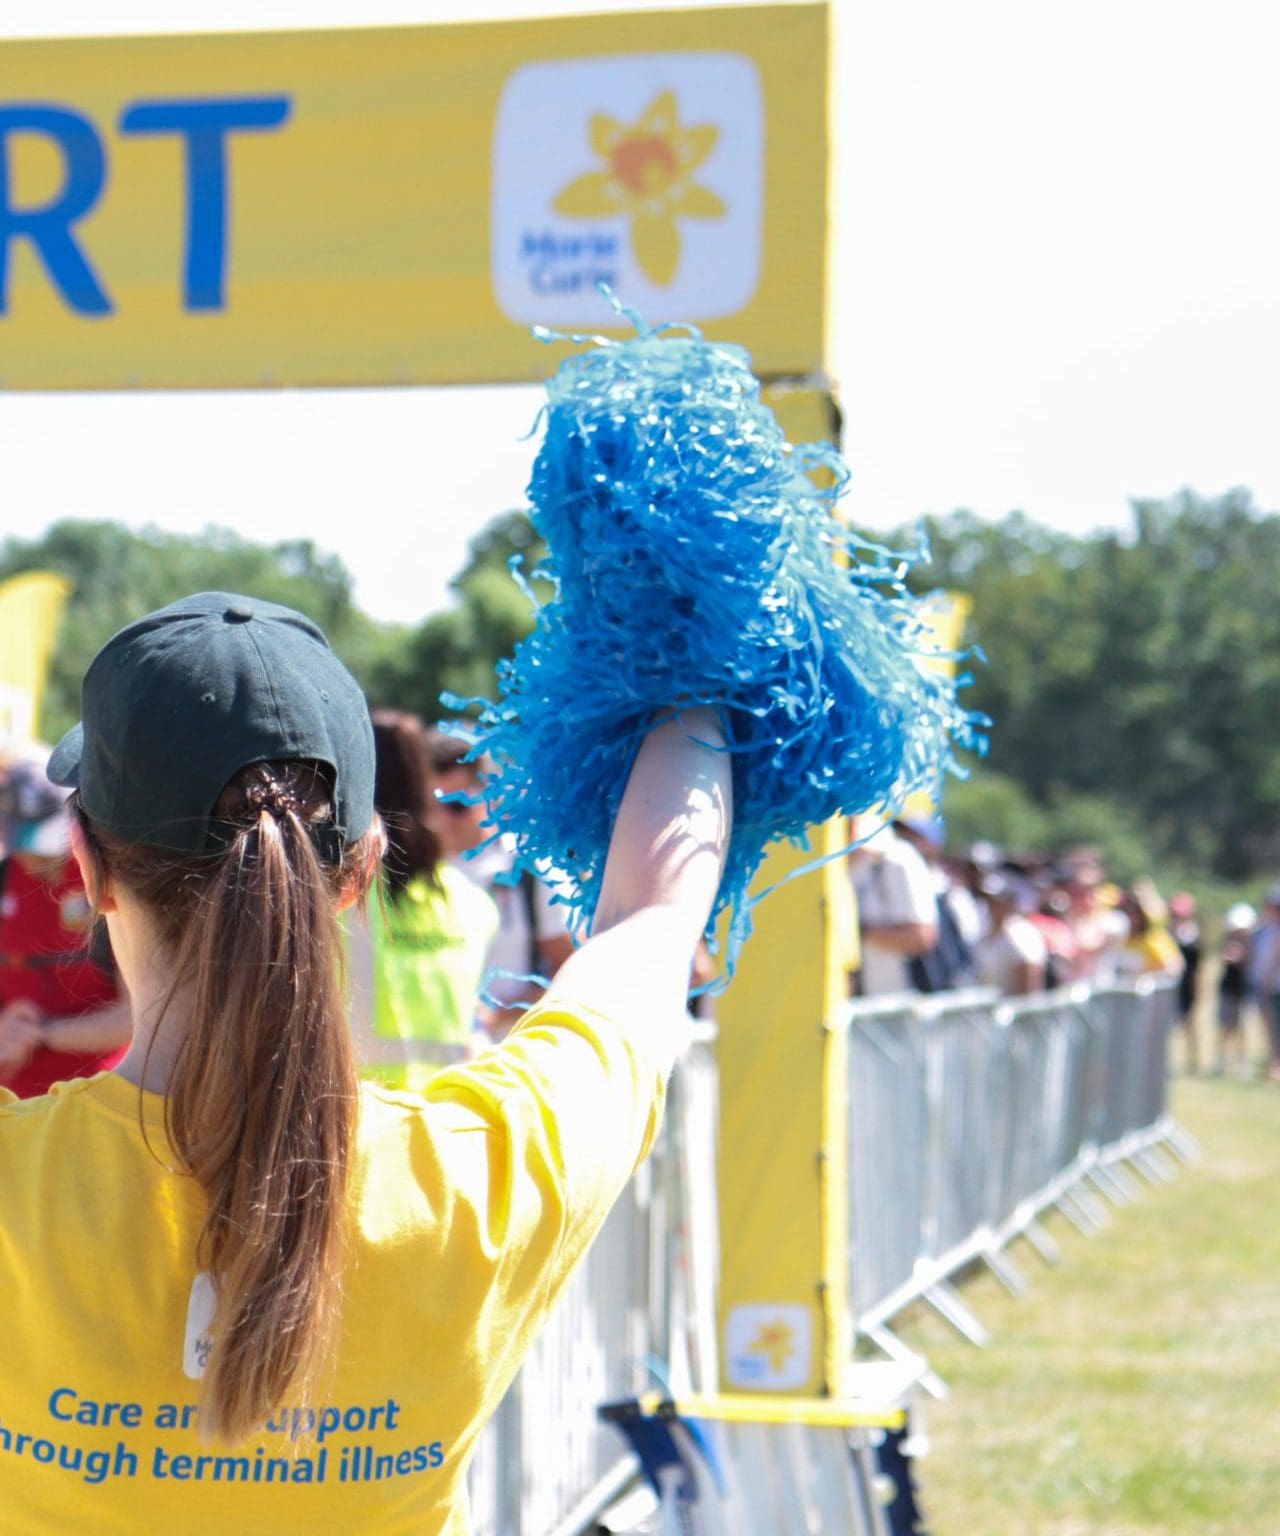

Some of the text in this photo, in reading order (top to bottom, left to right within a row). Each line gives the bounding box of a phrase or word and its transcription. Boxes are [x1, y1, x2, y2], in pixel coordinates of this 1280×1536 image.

[48, 1387, 144, 1429] Care
[256, 1399, 400, 1443] upport
[153, 1446, 328, 1483] terminal
[339, 1441, 445, 1483] illness
